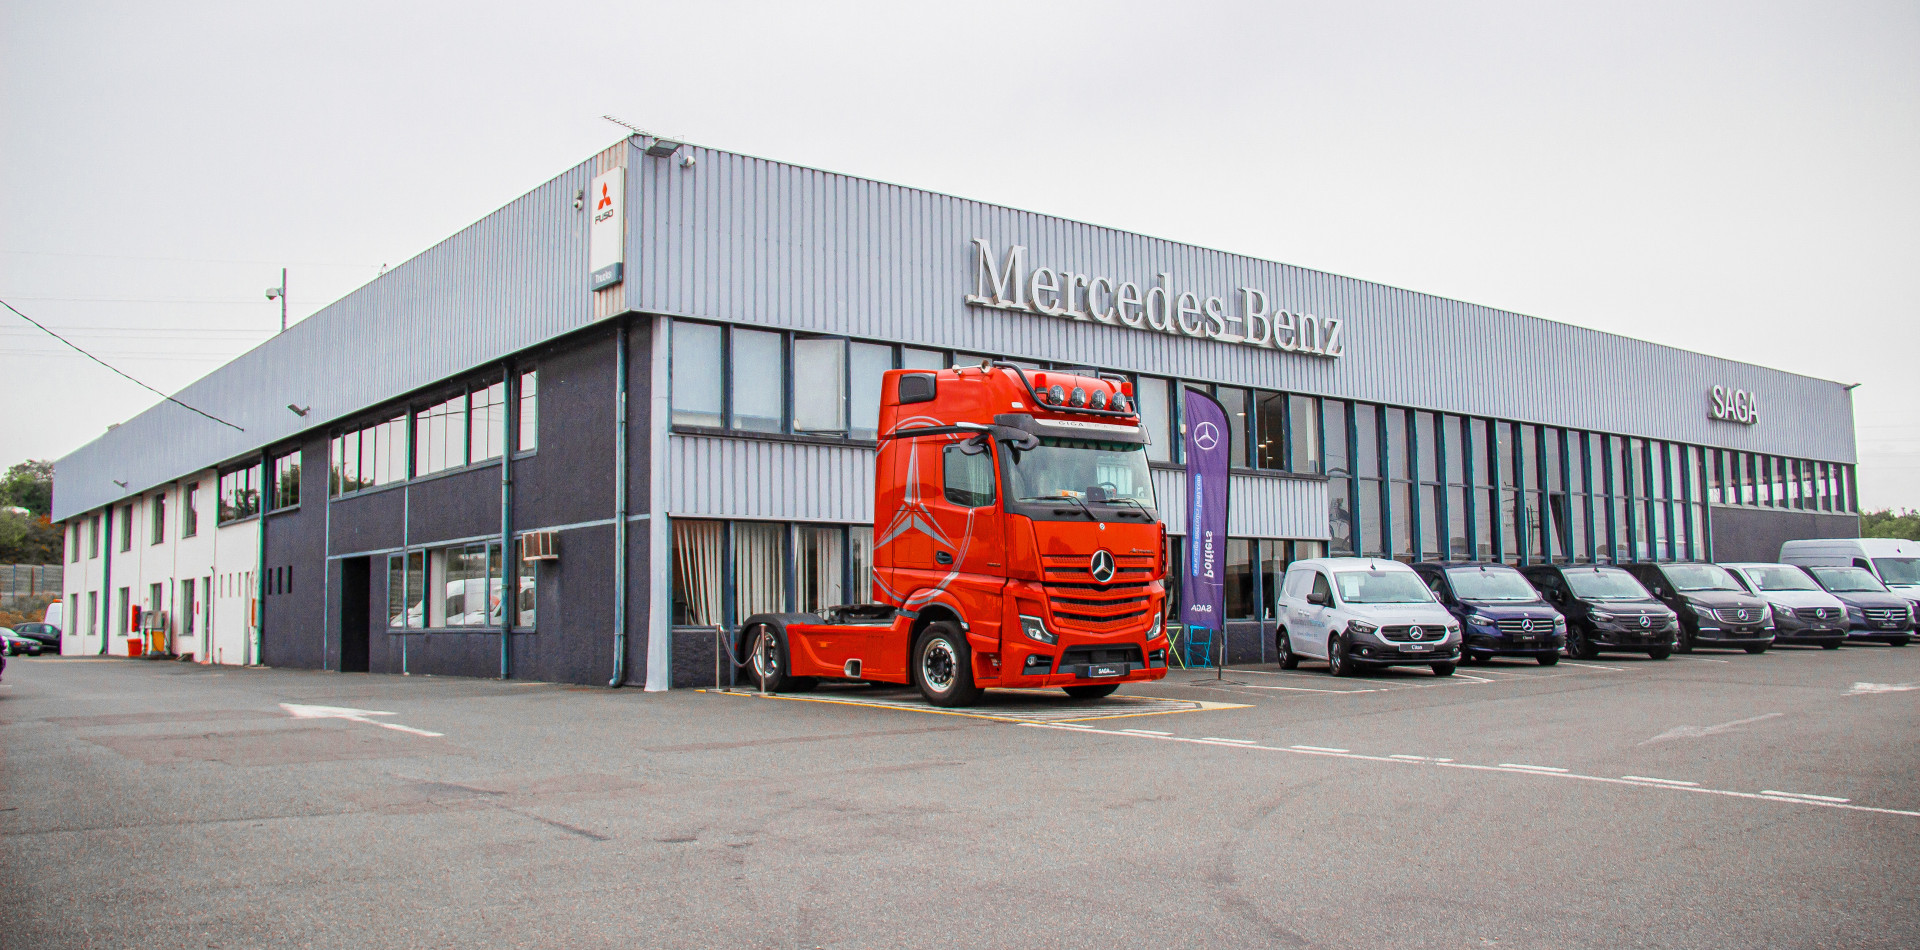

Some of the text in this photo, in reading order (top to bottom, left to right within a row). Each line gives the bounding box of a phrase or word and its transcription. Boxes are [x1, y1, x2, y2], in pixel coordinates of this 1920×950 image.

[595, 209, 613, 224] FUSO
[966, 237, 1344, 358] Mercedes-Benz
[1711, 384, 1760, 424] SAGA
